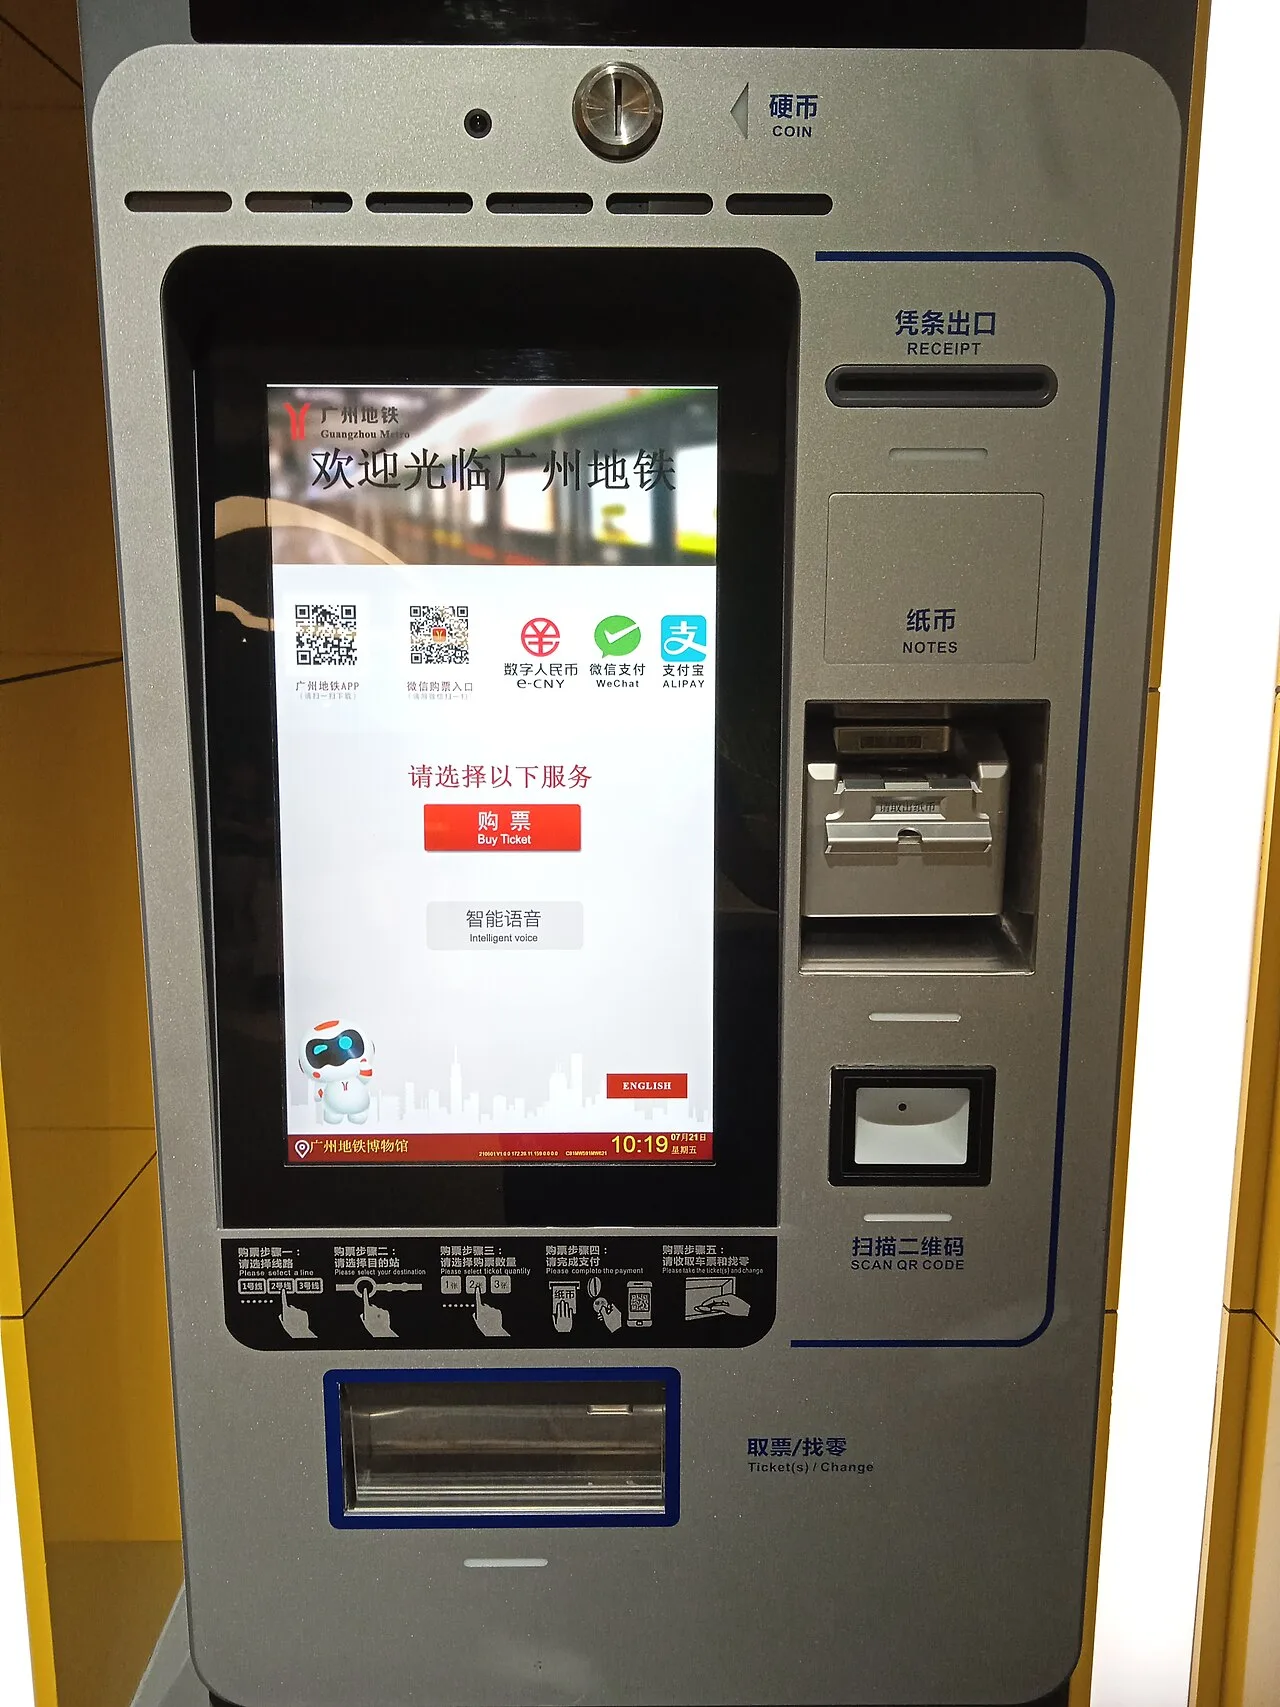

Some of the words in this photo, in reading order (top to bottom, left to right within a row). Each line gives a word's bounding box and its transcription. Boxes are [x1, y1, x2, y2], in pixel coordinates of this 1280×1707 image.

[769, 94, 818, 119] 硬币
[772, 125, 812, 137] COIN
[895, 309, 996, 336] 凭条出口
[907, 342, 981, 355] RECEIPT
[321, 406, 399, 424] 广州地铁
[320, 429, 377, 440] Guangzhou
[379, 429, 410, 438] Metro
[310, 447, 677, 492] 欢迎光临广州地铁
[906, 608, 956, 632] 纸币
[902, 641, 958, 653] NOTES
[503, 663, 578, 676] 数字人民币
[589, 663, 645, 676] 微信支付
[662, 664, 704, 677] 支付宝
[295, 681, 360, 692] 广州地铁APP
[406, 681, 473, 692] 微信购票入口
[516, 679, 565, 689] e-CNY
[596, 680, 640, 688] WeChat
[662, 680, 705, 689] ALIPAY
[408, 764, 592, 789] 请选择以下服务
[477, 834, 499, 847] Buy
[500, 834, 532, 845] Ticket
[466, 909, 541, 928] 智能语音
[469, 933, 513, 944] Intelligent
[623, 1082, 672, 1090] ENGLISH
[670, 1133, 707, 1142] 07月21日
[310, 1139, 409, 1154] 广州地铁博物馆
[611, 1135, 669, 1154] 10:19
[671, 1145, 697, 1155] 星期五
[852, 1236, 965, 1257] 扫描二维码
[239, 1258, 294, 1269] 请选择线路
[334, 1258, 400, 1268] 请选择目的站
[440, 1257, 517, 1267] 请选择购票数量
[545, 1256, 600, 1267] 请完成支付
[662, 1256, 750, 1266] 请收取车票和找零
[851, 1259, 893, 1270] SCAN
[897, 1259, 918, 1270] QR
[922, 1259, 965, 1270] CODE
[504, 1267, 531, 1276] quantity
[242, 1282, 263, 1290] 1号线
[554, 1289, 575, 1299] 纸币
[747, 1438, 847, 1456] 取票/找零
[748, 1462, 809, 1474] Ticket(s)
[820, 1462, 874, 1474] Change
